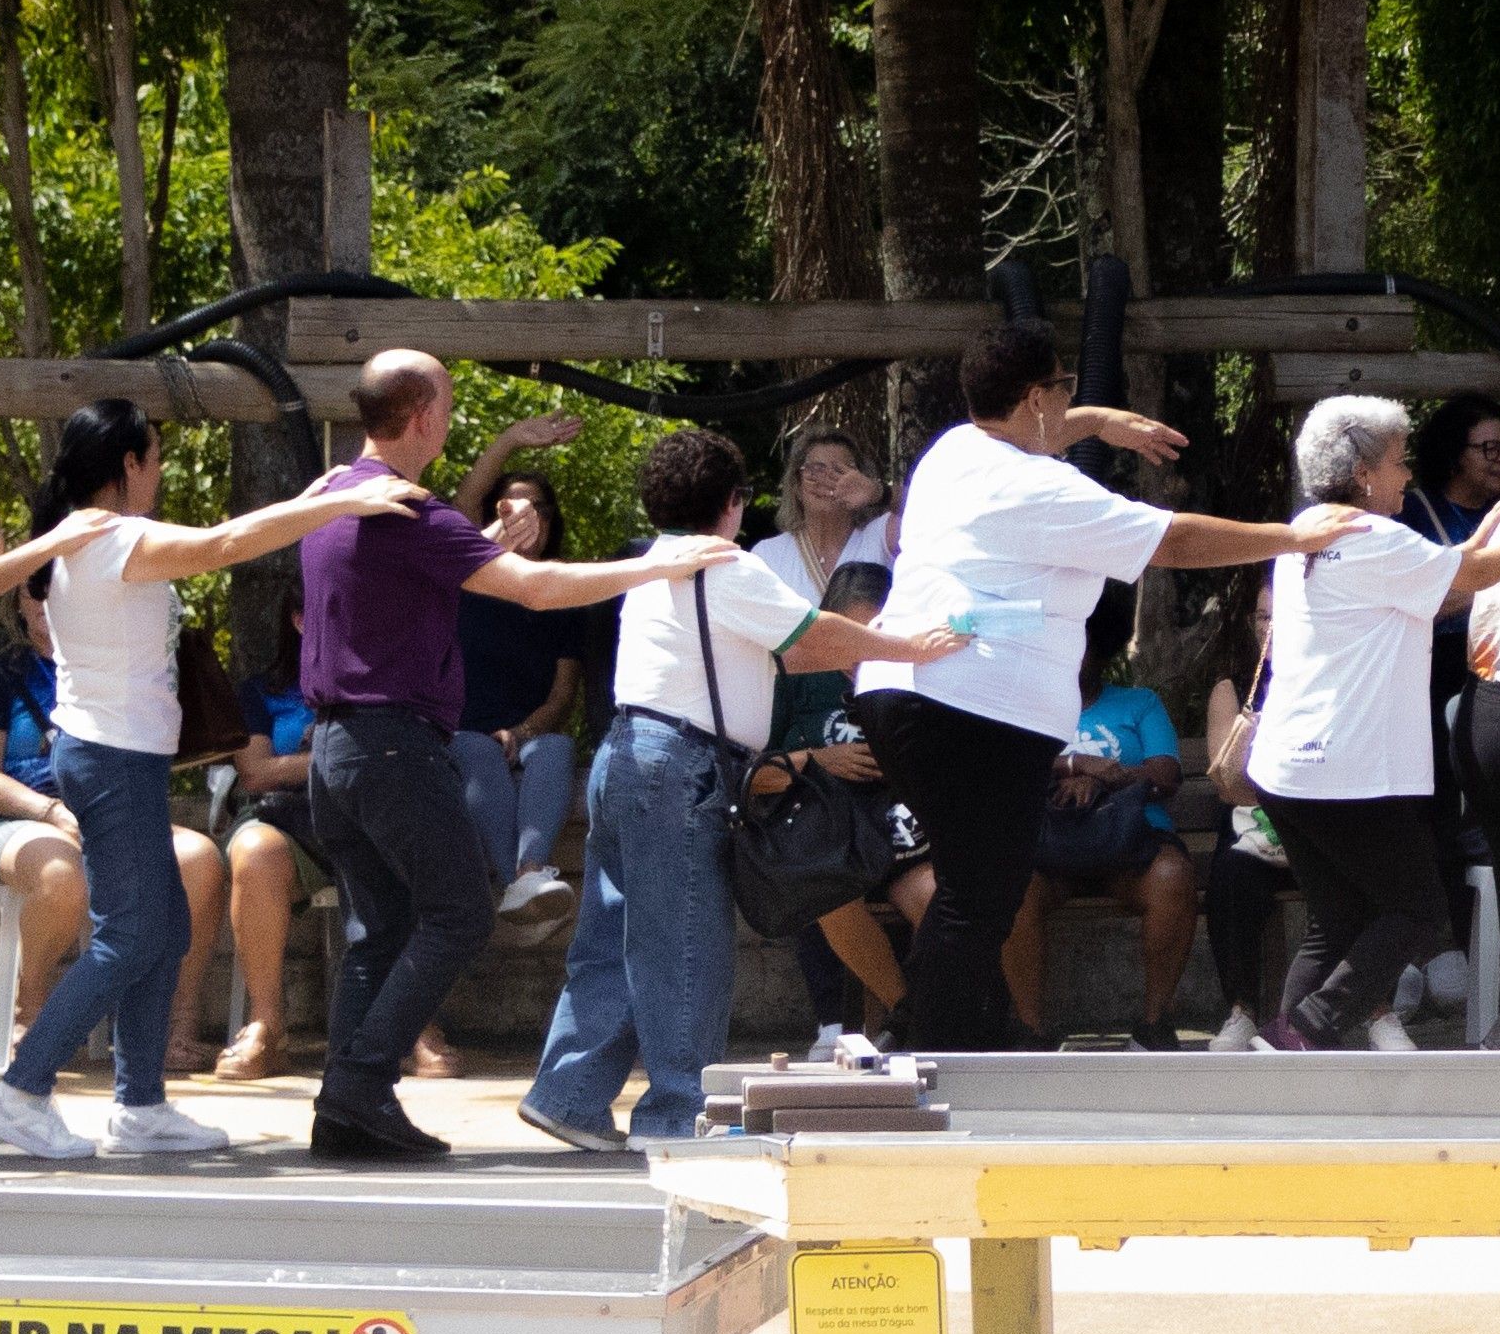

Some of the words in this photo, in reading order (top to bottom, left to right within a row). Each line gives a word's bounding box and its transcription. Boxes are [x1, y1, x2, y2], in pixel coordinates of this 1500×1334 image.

[831, 1273, 900, 1292] ATENÇÃO:
[805, 1307, 843, 1317] Respeite
[860, 1307, 890, 1316] regras
[907, 1304, 928, 1313] bom
[818, 1321, 835, 1329] uso
